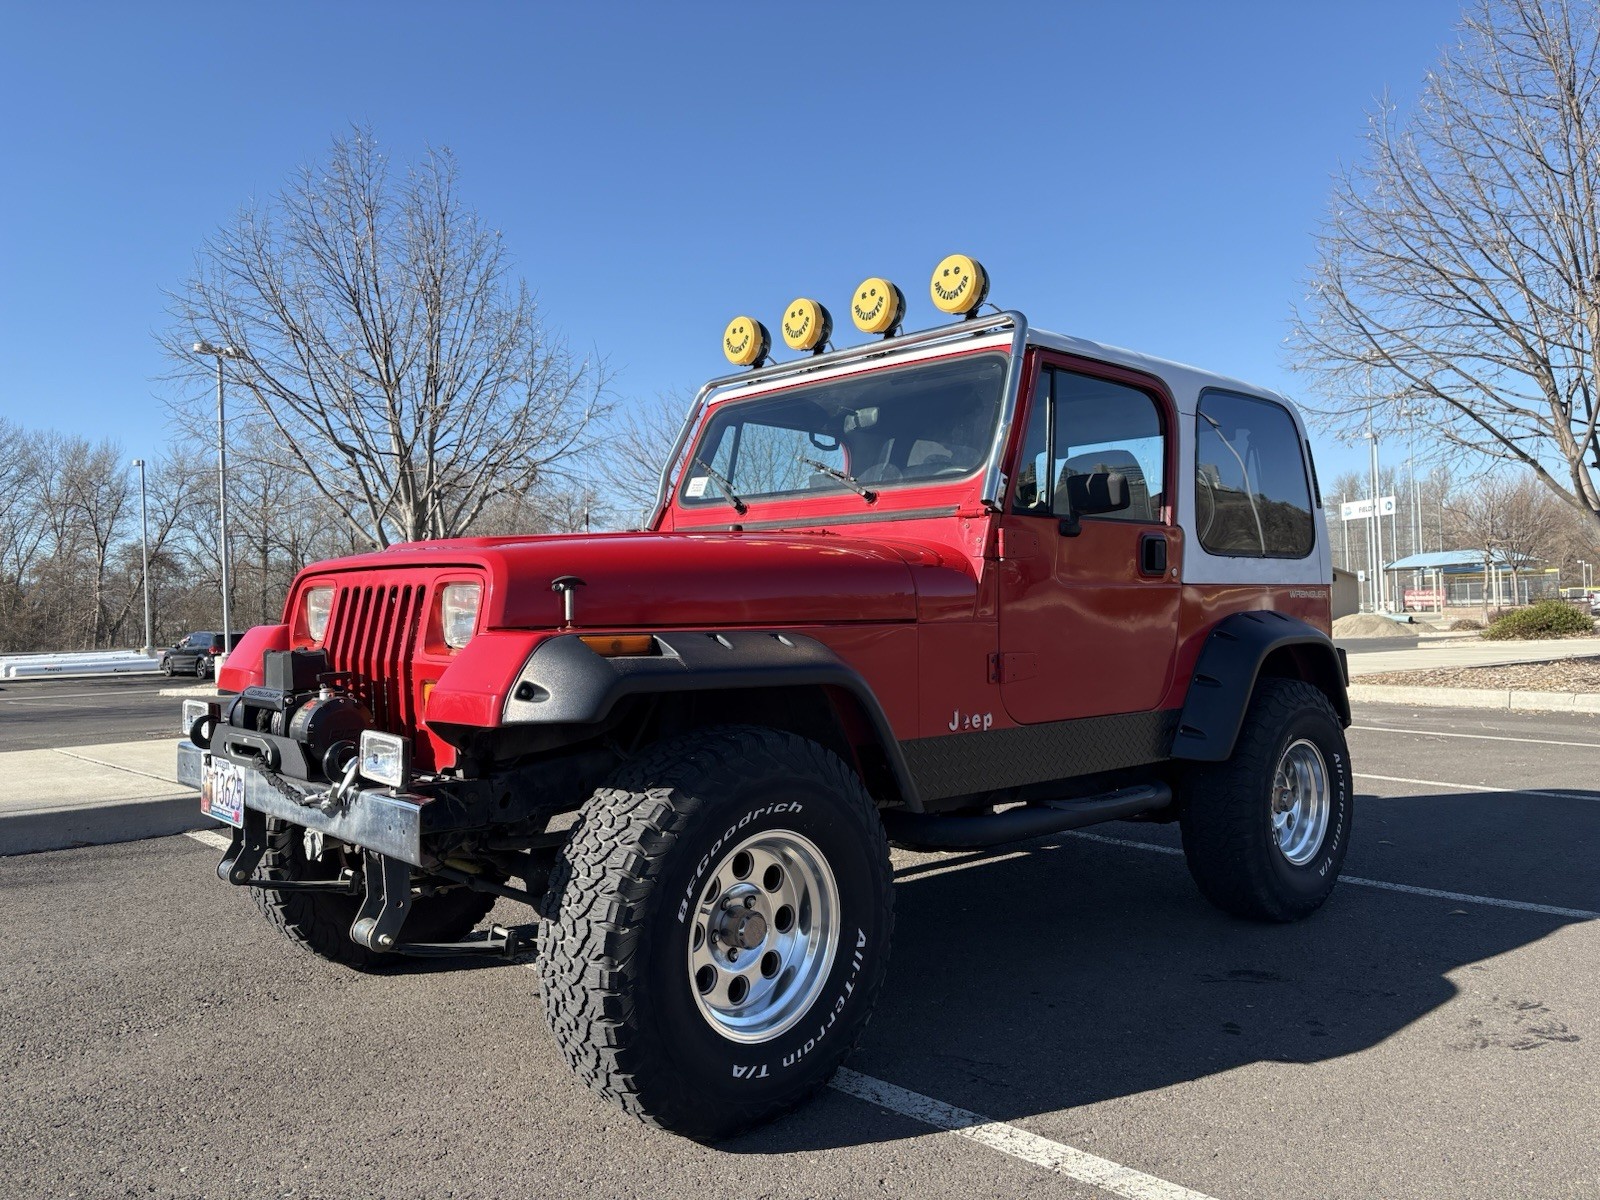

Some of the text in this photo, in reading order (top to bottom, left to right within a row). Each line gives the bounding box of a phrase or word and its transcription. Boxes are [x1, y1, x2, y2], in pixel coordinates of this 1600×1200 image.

[934, 275, 969, 300] DAYLIGHTER
[854, 296, 884, 321] DAYLIGHTER
[784, 316, 810, 339] DAYLIGHTER
[948, 709, 993, 731] Jeep
[677, 801, 803, 924] BFGoodrich
[732, 927, 867, 1080] All-Terrain T/A
